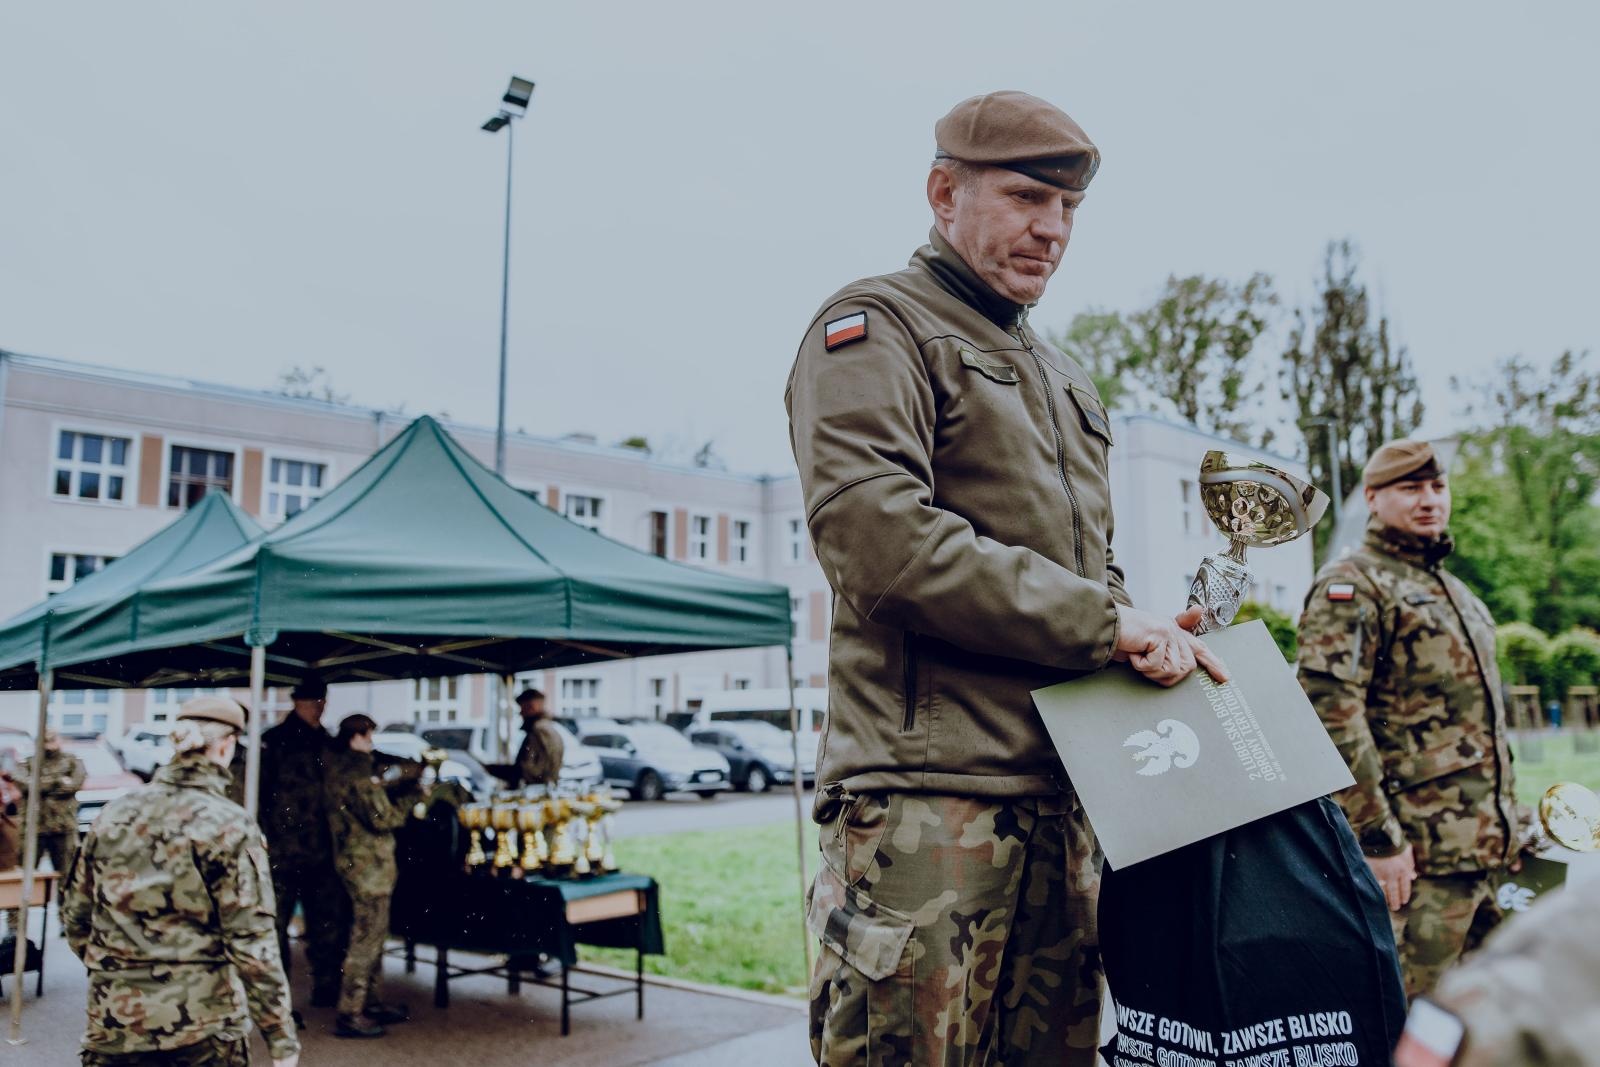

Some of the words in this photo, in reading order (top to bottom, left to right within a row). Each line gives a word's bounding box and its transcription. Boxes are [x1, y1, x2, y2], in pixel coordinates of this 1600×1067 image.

[1196, 670, 1231, 719] BRYGADA
[1217, 682, 1253, 737] TERYTORIA
[1221, 718, 1257, 771] LUBELSKA
[1244, 738, 1277, 782] OBRONY
[1116, 1002, 1155, 1037] WSZE
[1221, 1018, 1287, 1055] ZAWSZE
[1287, 1010, 1353, 1040] BLISKO
[1293, 1041, 1359, 1067] BLISKO
